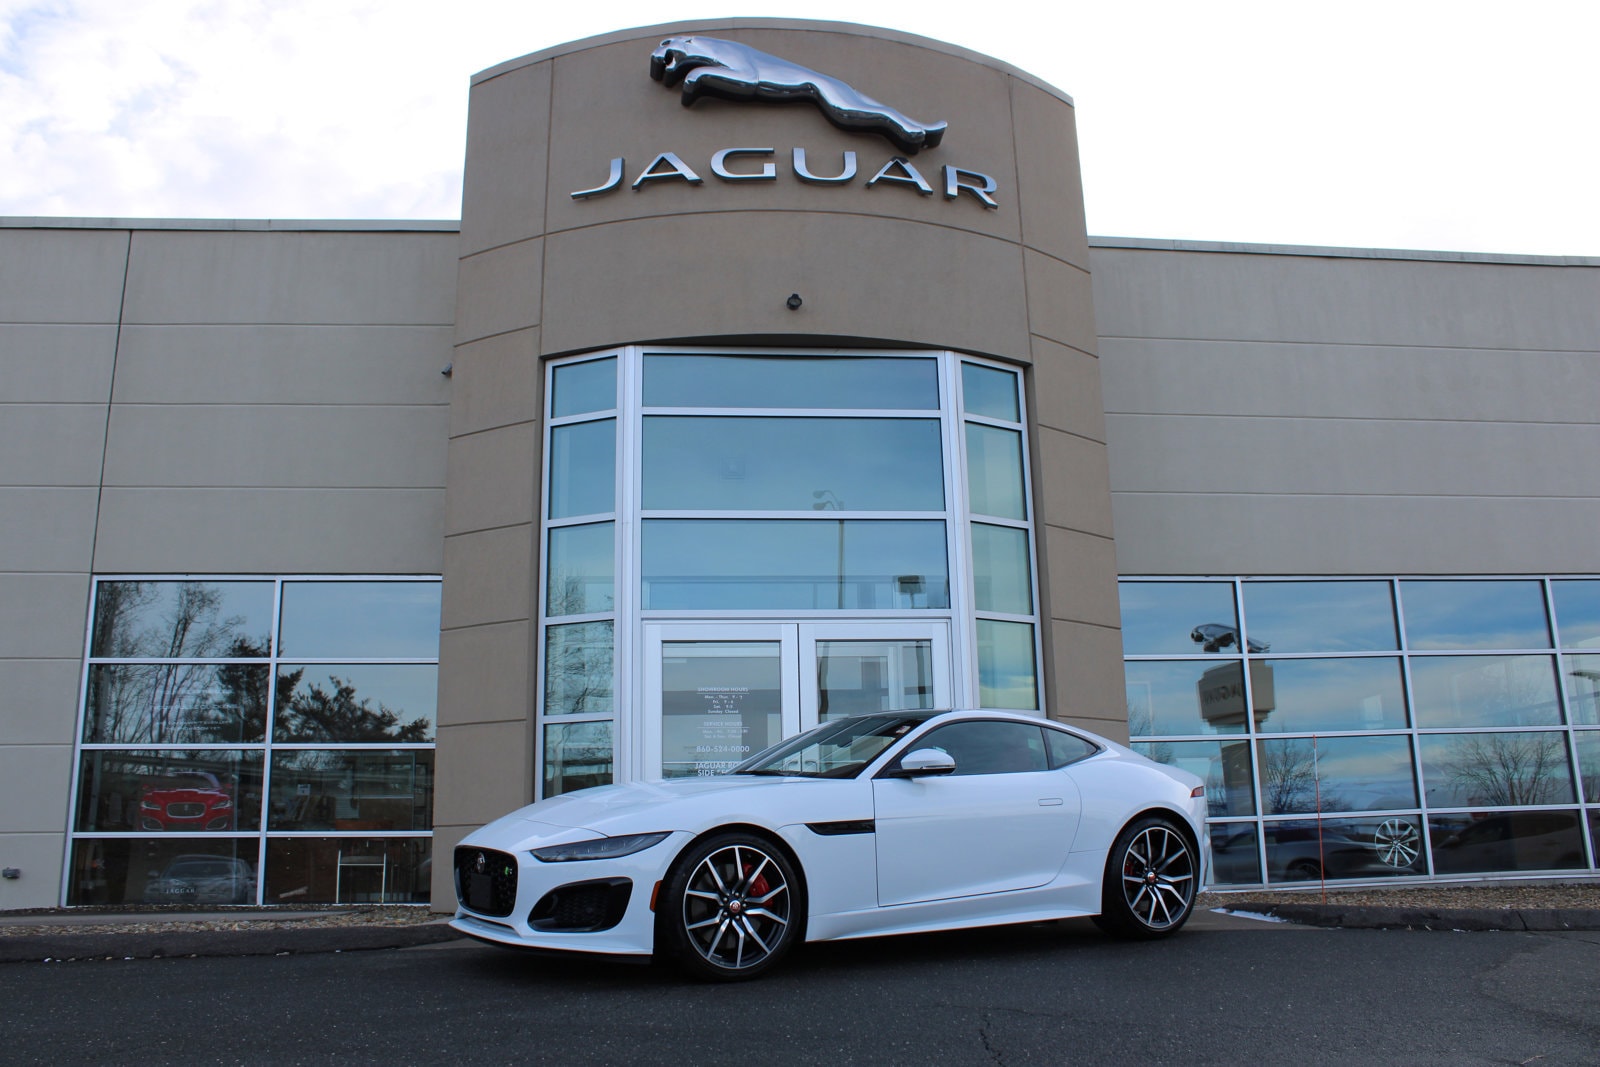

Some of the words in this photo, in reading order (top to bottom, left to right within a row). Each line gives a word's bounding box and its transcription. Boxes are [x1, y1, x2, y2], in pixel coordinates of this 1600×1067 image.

[570, 146, 999, 210] JAGUAR
[696, 745, 750, 753] 860-524-0000
[695, 761, 726, 769] JAGUAR
[697, 769, 715, 777] SIDE
